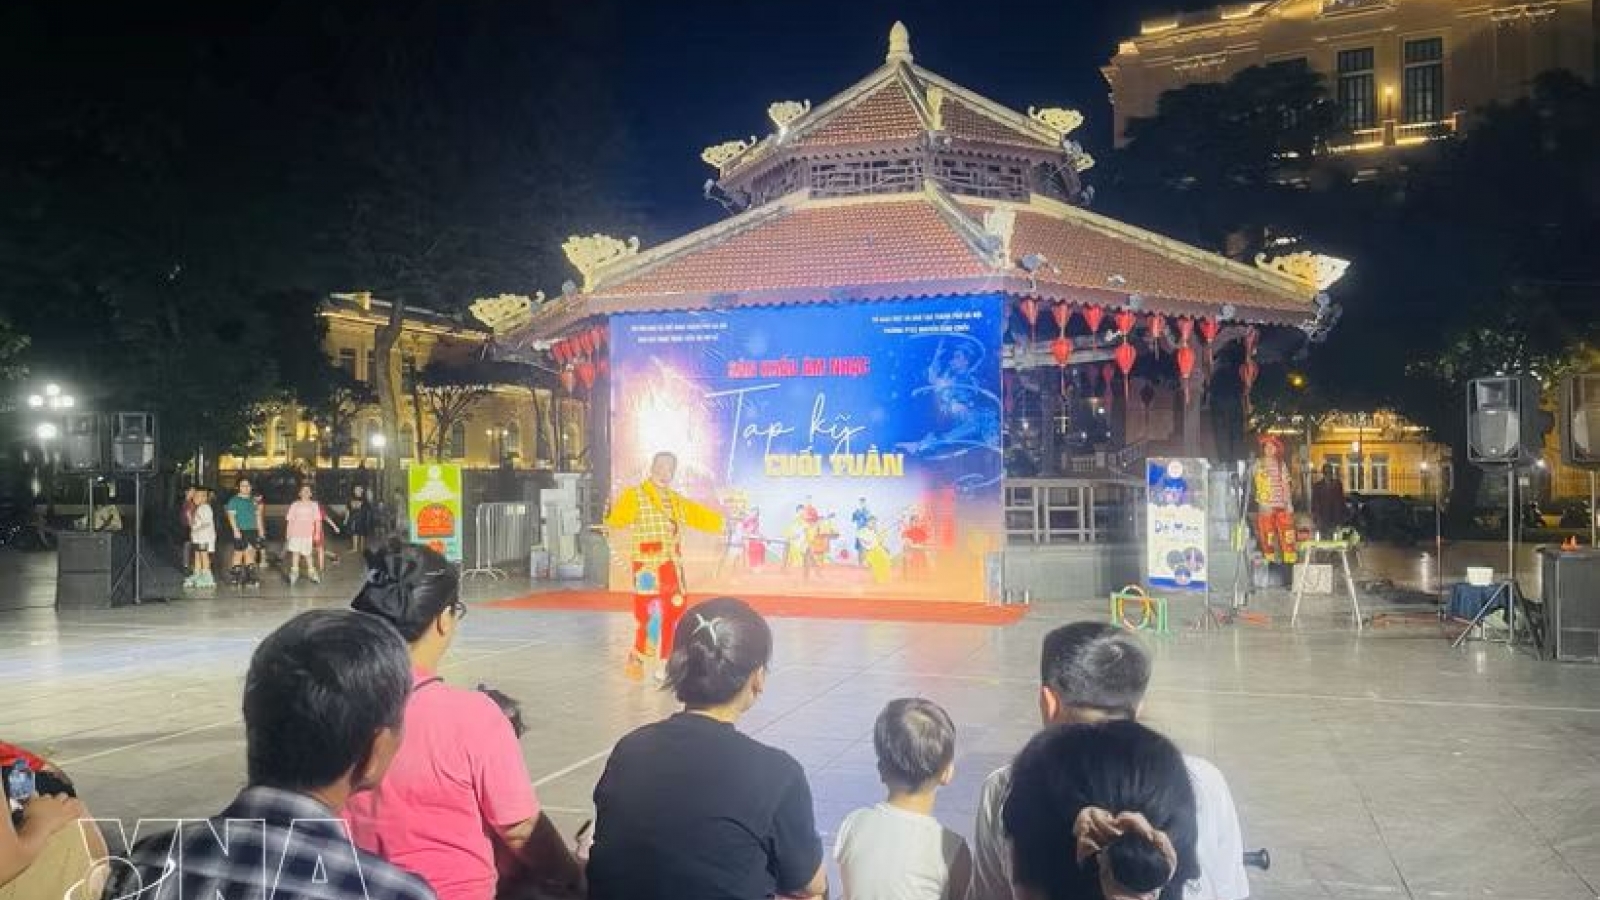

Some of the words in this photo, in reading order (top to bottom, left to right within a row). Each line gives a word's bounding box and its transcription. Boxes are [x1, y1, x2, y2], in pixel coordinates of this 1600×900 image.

[704, 383, 795, 484] Tạp
[810, 392, 867, 462] kỹ
[764, 446, 823, 477] CUỐI
